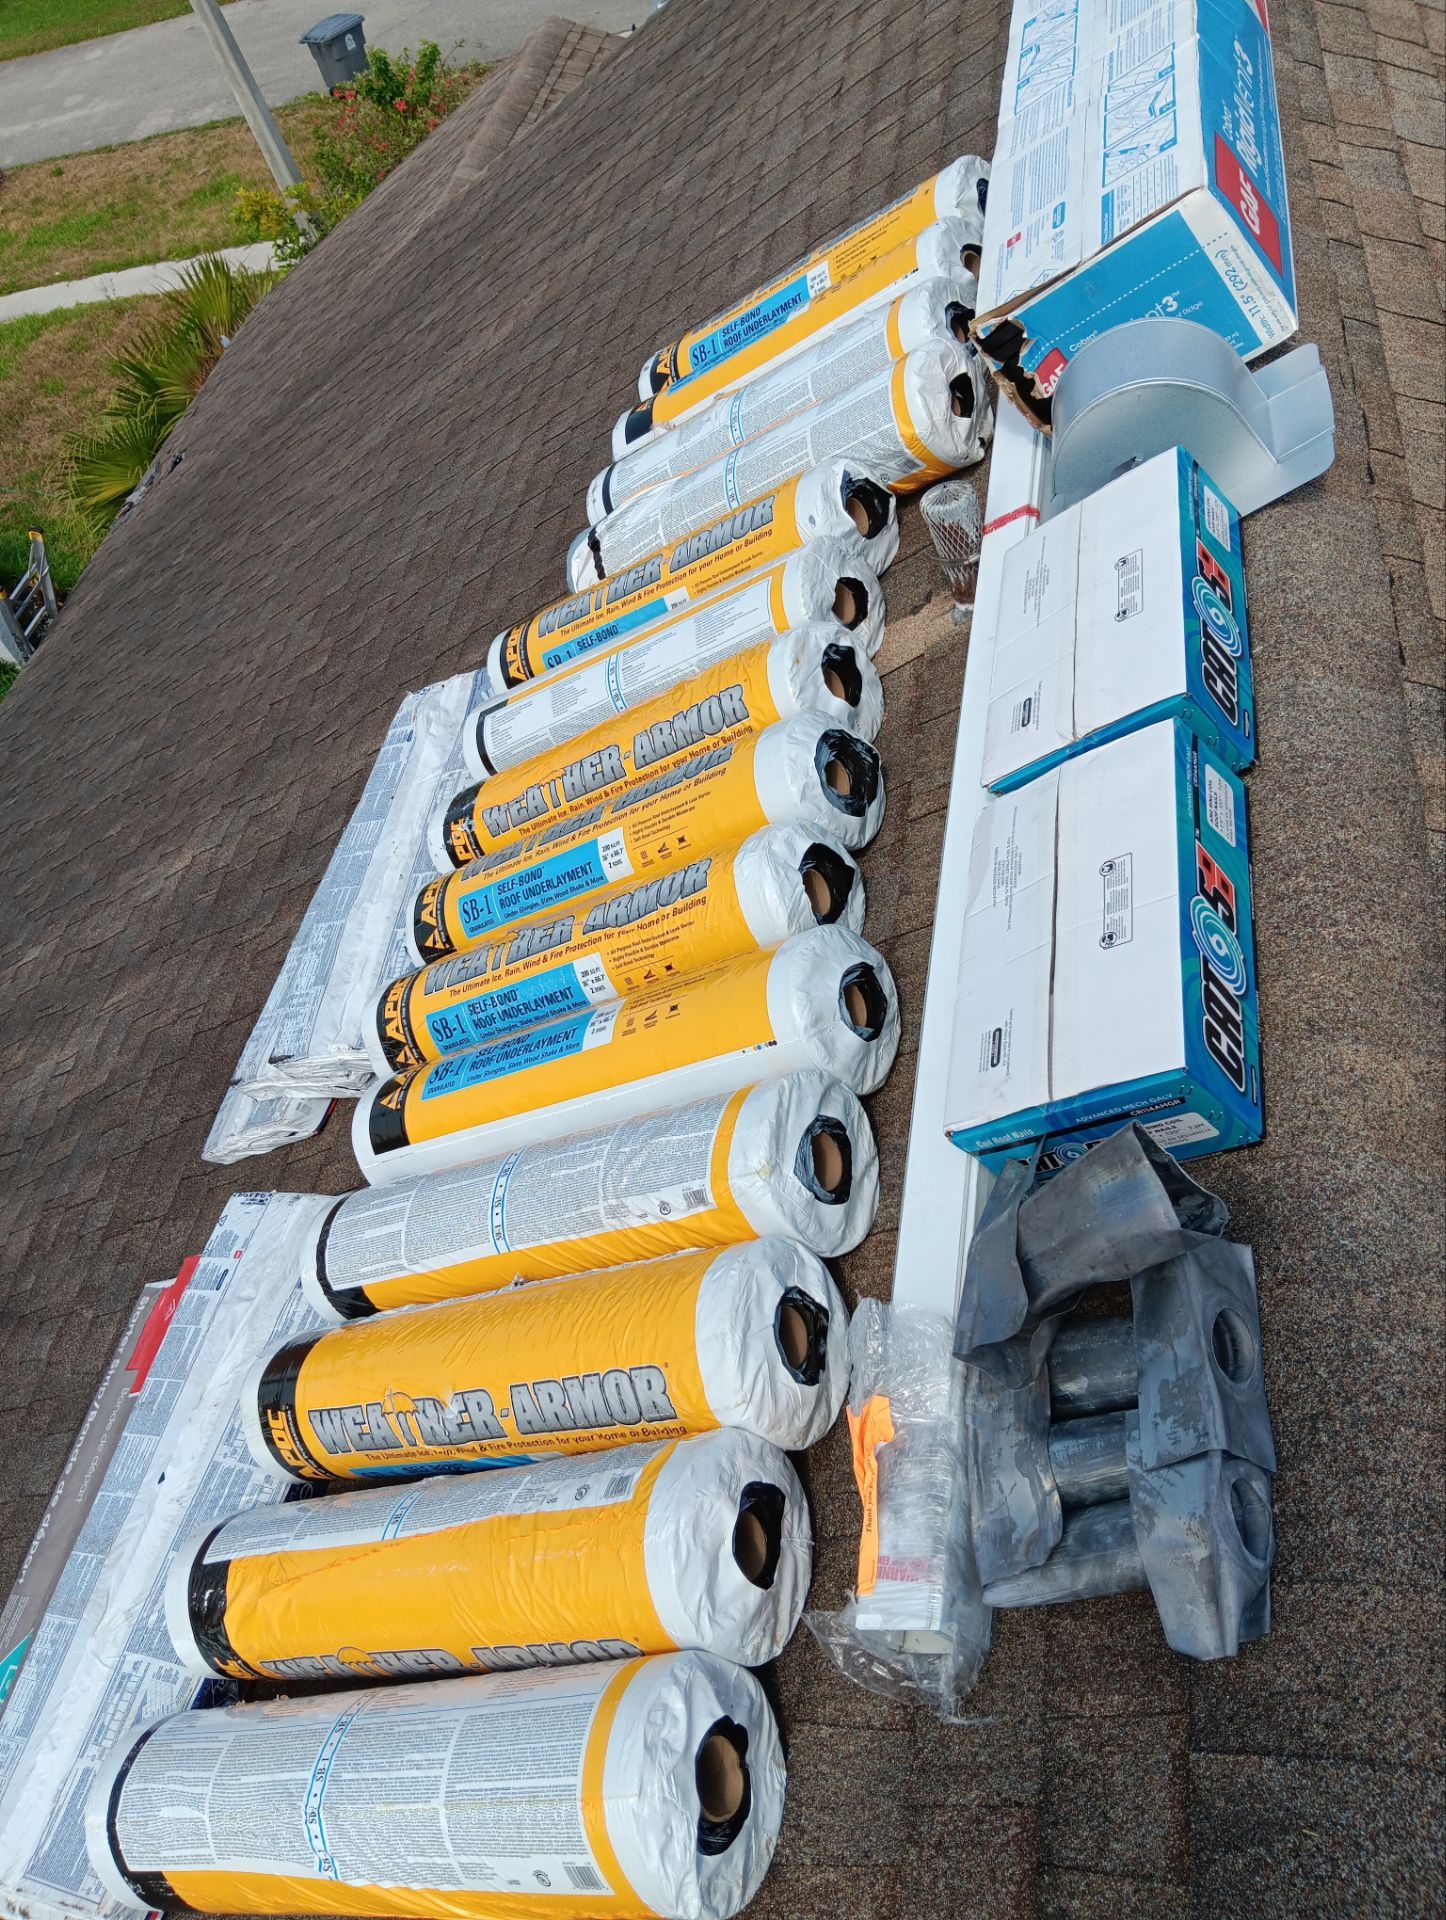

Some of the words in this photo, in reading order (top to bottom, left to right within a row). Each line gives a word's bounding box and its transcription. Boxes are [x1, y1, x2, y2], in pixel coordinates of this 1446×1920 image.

[1239, 167, 1260, 236] GAF
[722, 307, 761, 337] SELF-BOND
[723, 331, 742, 349] ROOF
[743, 293, 802, 338] UNDERLAYMENT
[1260, 313, 1275, 339] Width:
[692, 339, 717, 367] SB-1
[538, 495, 774, 638] WEATHER-ARMOR
[559, 627, 570, 637] The
[569, 615, 595, 632] Ultimate
[619, 595, 637, 608] Wind
[635, 592, 642, 600] &
[643, 587, 654, 596] Fire
[656, 570, 688, 590] Protection
[686, 565, 698, 575] for
[697, 557, 714, 570] your
[713, 547, 734, 562] Home
[734, 542, 744, 552] or
[743, 528, 773, 548] Building
[482, 684, 749, 837] WEATHER-ARMOR
[518, 825, 531, 836] The
[530, 813, 558, 831] Ultimate
[584, 792, 604, 806] Wind
[603, 789, 610, 798] &
[609, 783, 624, 795] Fire
[623, 767, 659, 789] Protection
[658, 761, 672, 773] for
[671, 753, 689, 767] your
[688, 743, 712, 759] Home
[711, 738, 721, 749] or
[720, 724, 753, 744] Building
[497, 891, 522, 911] ROOF
[520, 860, 594, 901] UNDERLAYMENT
[503, 908, 519, 919] Under
[517, 900, 540, 913] Shingles,
[540, 894, 555, 904] Slate,
[553, 887, 571, 899] Wood
[569, 881, 585, 892] Shake
[589, 874, 604, 884] More
[424, 858, 711, 996] WEATHER-ARMOR
[462, 893, 492, 925] SB-1
[448, 987, 461, 998] The
[460, 976, 491, 993] Ultimate
[521, 957, 542, 970] Wind
[540, 954, 548, 963] &
[549, 948, 564, 960] Fire
[563, 934, 603, 955] Protection
[603, 930, 615, 940] for
[635, 916, 660, 932] Home
[659, 911, 670, 922] or
[670, 895, 708, 917] Building
[431, 1013, 463, 1045] SB-1
[471, 1011, 500, 1030] ROOF
[498, 986, 575, 1021] UNDERLAYMENT
[429, 1055, 462, 1085] SB-1
[466, 1053, 496, 1072] ROOF
[493, 1027, 580, 1063] UNDERLAYMENT
[1075, 1106, 1121, 1123] ADVANCED
[1122, 1099, 1148, 1110] MECH
[1148, 1092, 1173, 1104] GALV
[1011, 1126, 1034, 1139] Nails
[115, 1294, 151, 1354] Starter
[104, 1385, 129, 1432] Bande
[308, 1364, 678, 1454] WEATHER-ARMOR
[95, 1432, 110, 1452] de
[365, 1452, 378, 1462] The
[382, 1449, 415, 1460] Ultimate
[478, 1443, 485, 1452] &
[487, 1442, 503, 1451] Fire
[506, 1436, 553, 1450] Protection
[556, 1435, 570, 1445] for
[572, 1432, 594, 1444] your
[48, 1479, 66, 1508] de
[74, 1453, 101, 1504] départ
[15, 1511, 52, 1585] départ
